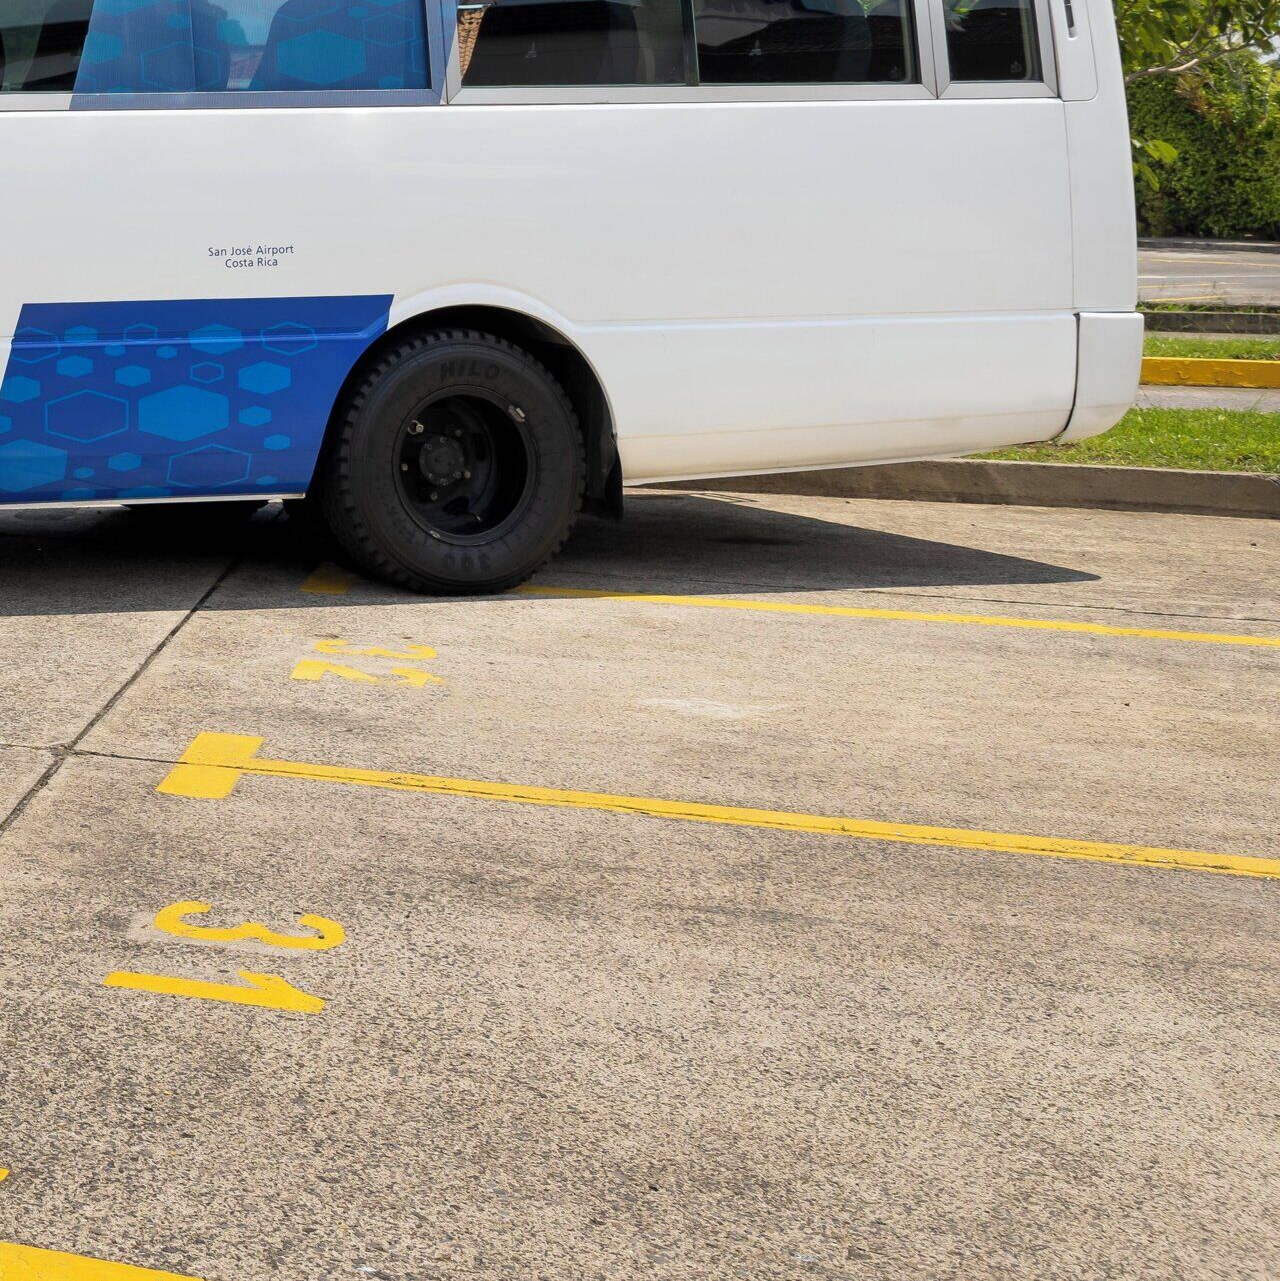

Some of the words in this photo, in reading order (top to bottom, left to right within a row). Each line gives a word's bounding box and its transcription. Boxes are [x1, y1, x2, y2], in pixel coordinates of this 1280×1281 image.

[208, 246, 227, 257] San
[230, 245, 253, 256] José
[255, 244, 295, 256] Airport
[225, 258, 254, 268] Costa
[257, 257, 278, 267] Rica
